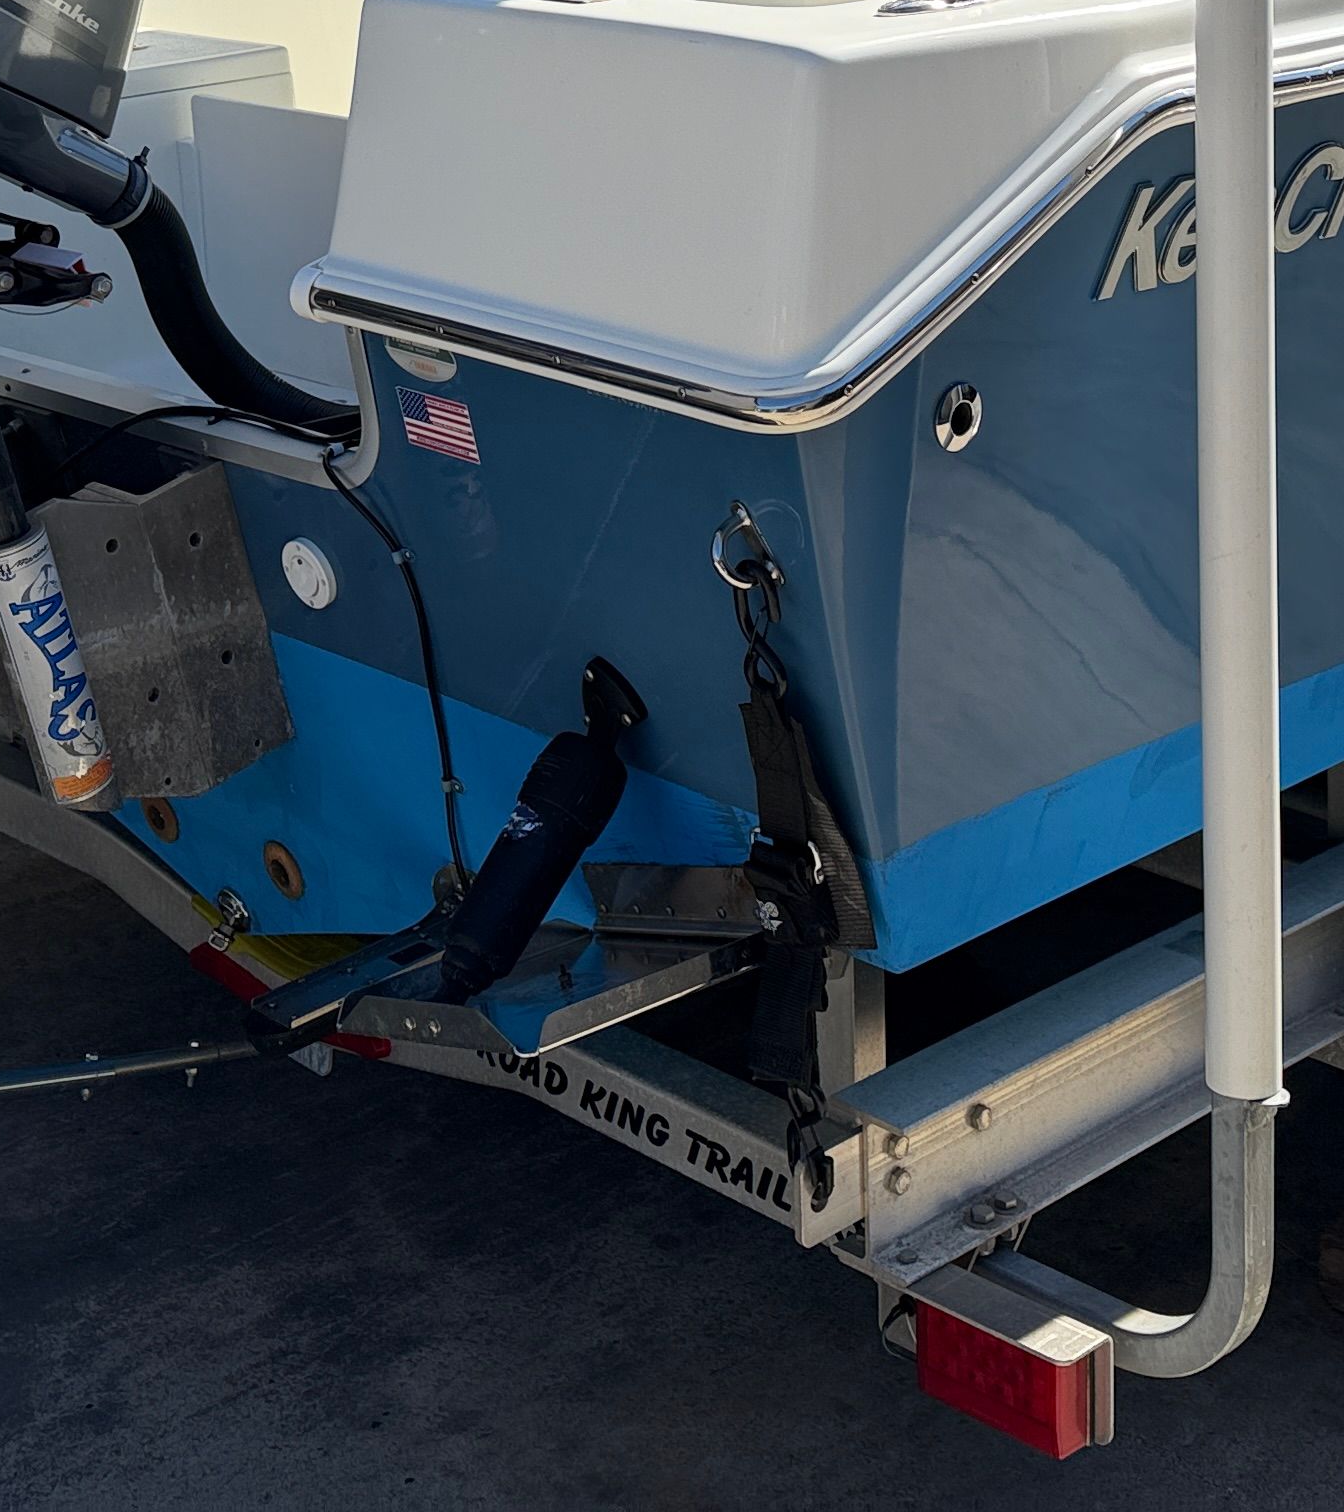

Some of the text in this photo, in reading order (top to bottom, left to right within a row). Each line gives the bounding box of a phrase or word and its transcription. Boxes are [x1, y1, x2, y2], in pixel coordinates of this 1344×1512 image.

[9, 591, 97, 742] ATLAS
[580, 1079, 671, 1148] KING
[686, 1129, 792, 1212] TRAIL
